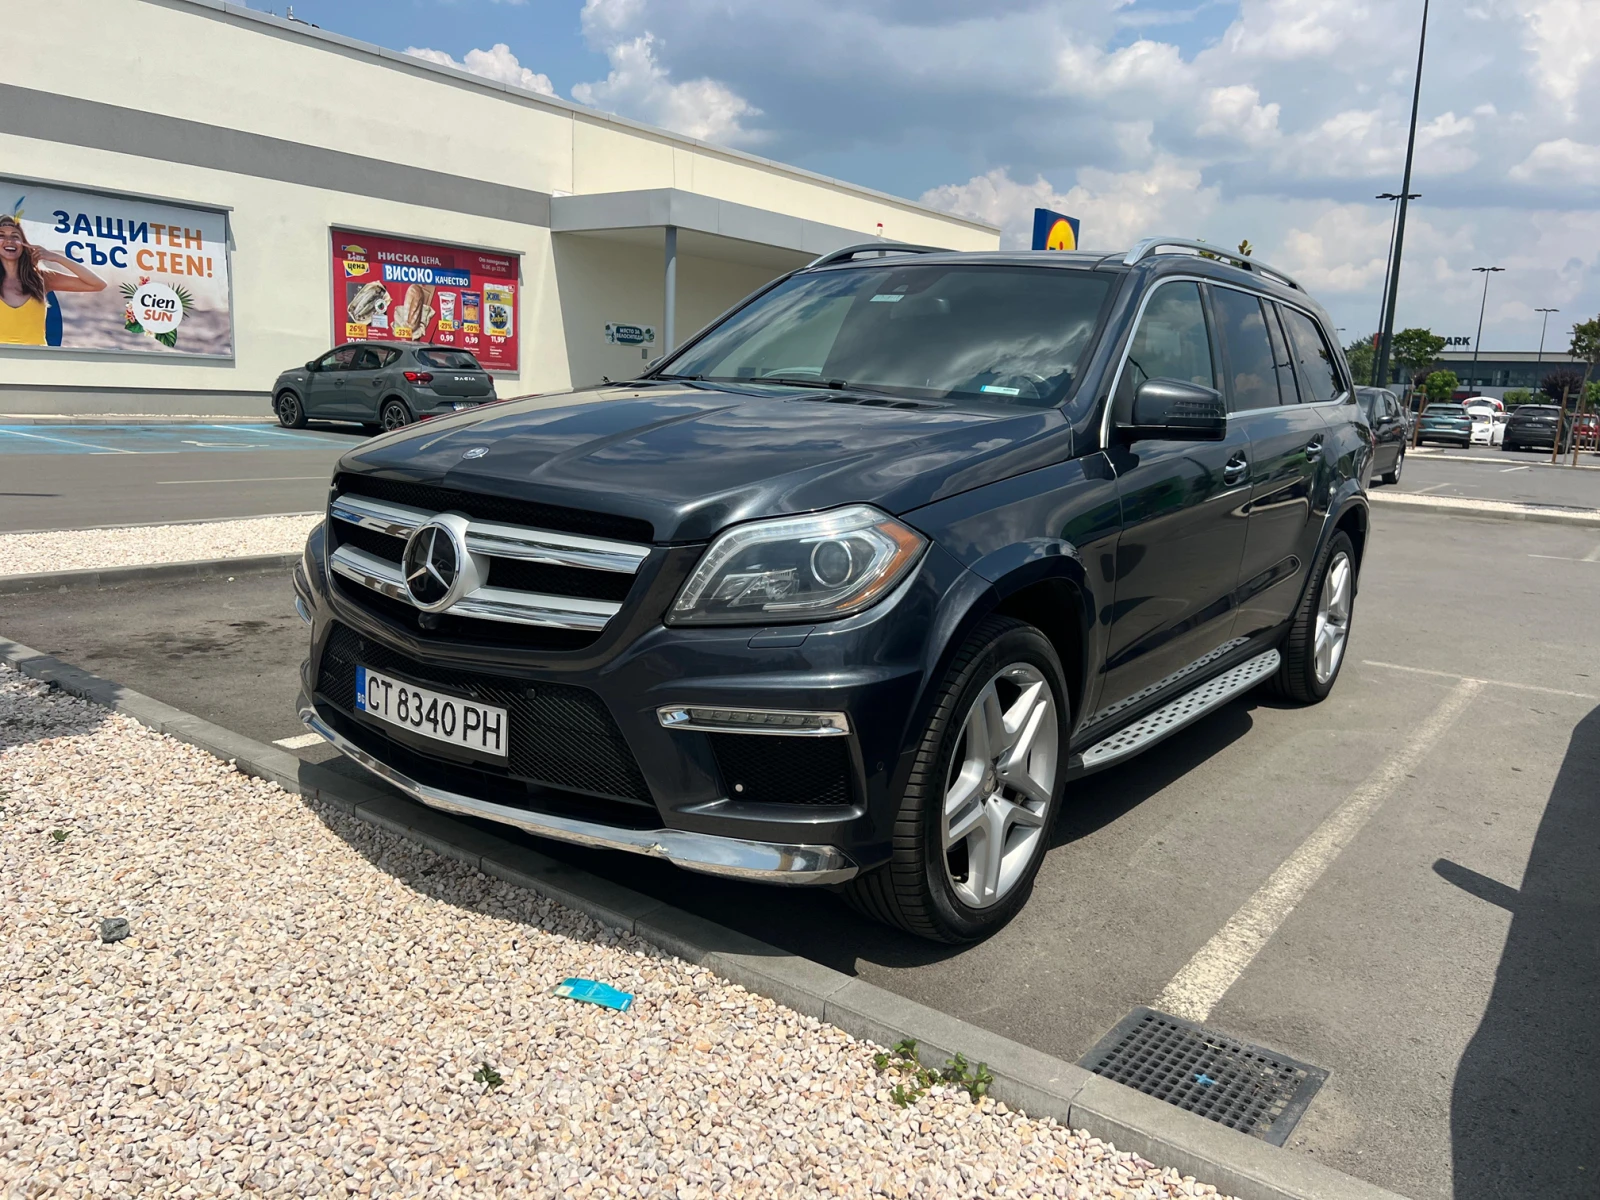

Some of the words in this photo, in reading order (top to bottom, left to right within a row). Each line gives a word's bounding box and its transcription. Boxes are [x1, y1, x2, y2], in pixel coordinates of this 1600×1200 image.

[53, 210, 203, 251] ЗАЩИТЕН
[65, 241, 128, 268] СЪС
[136, 249, 213, 278] CIEN!
[378, 251, 419, 263] НИСКА
[347, 263, 366, 271] цена
[384, 265, 433, 283] ВИСОКО
[434, 275, 469, 286] КАЧЕСТВО
[140, 293, 176, 309] Cien
[143, 309, 173, 322] SUN
[357, 692, 365, 704] BG
[368, 676, 393, 715] CT
[397, 687, 456, 737] 8340
[462, 705, 501, 750] PH
